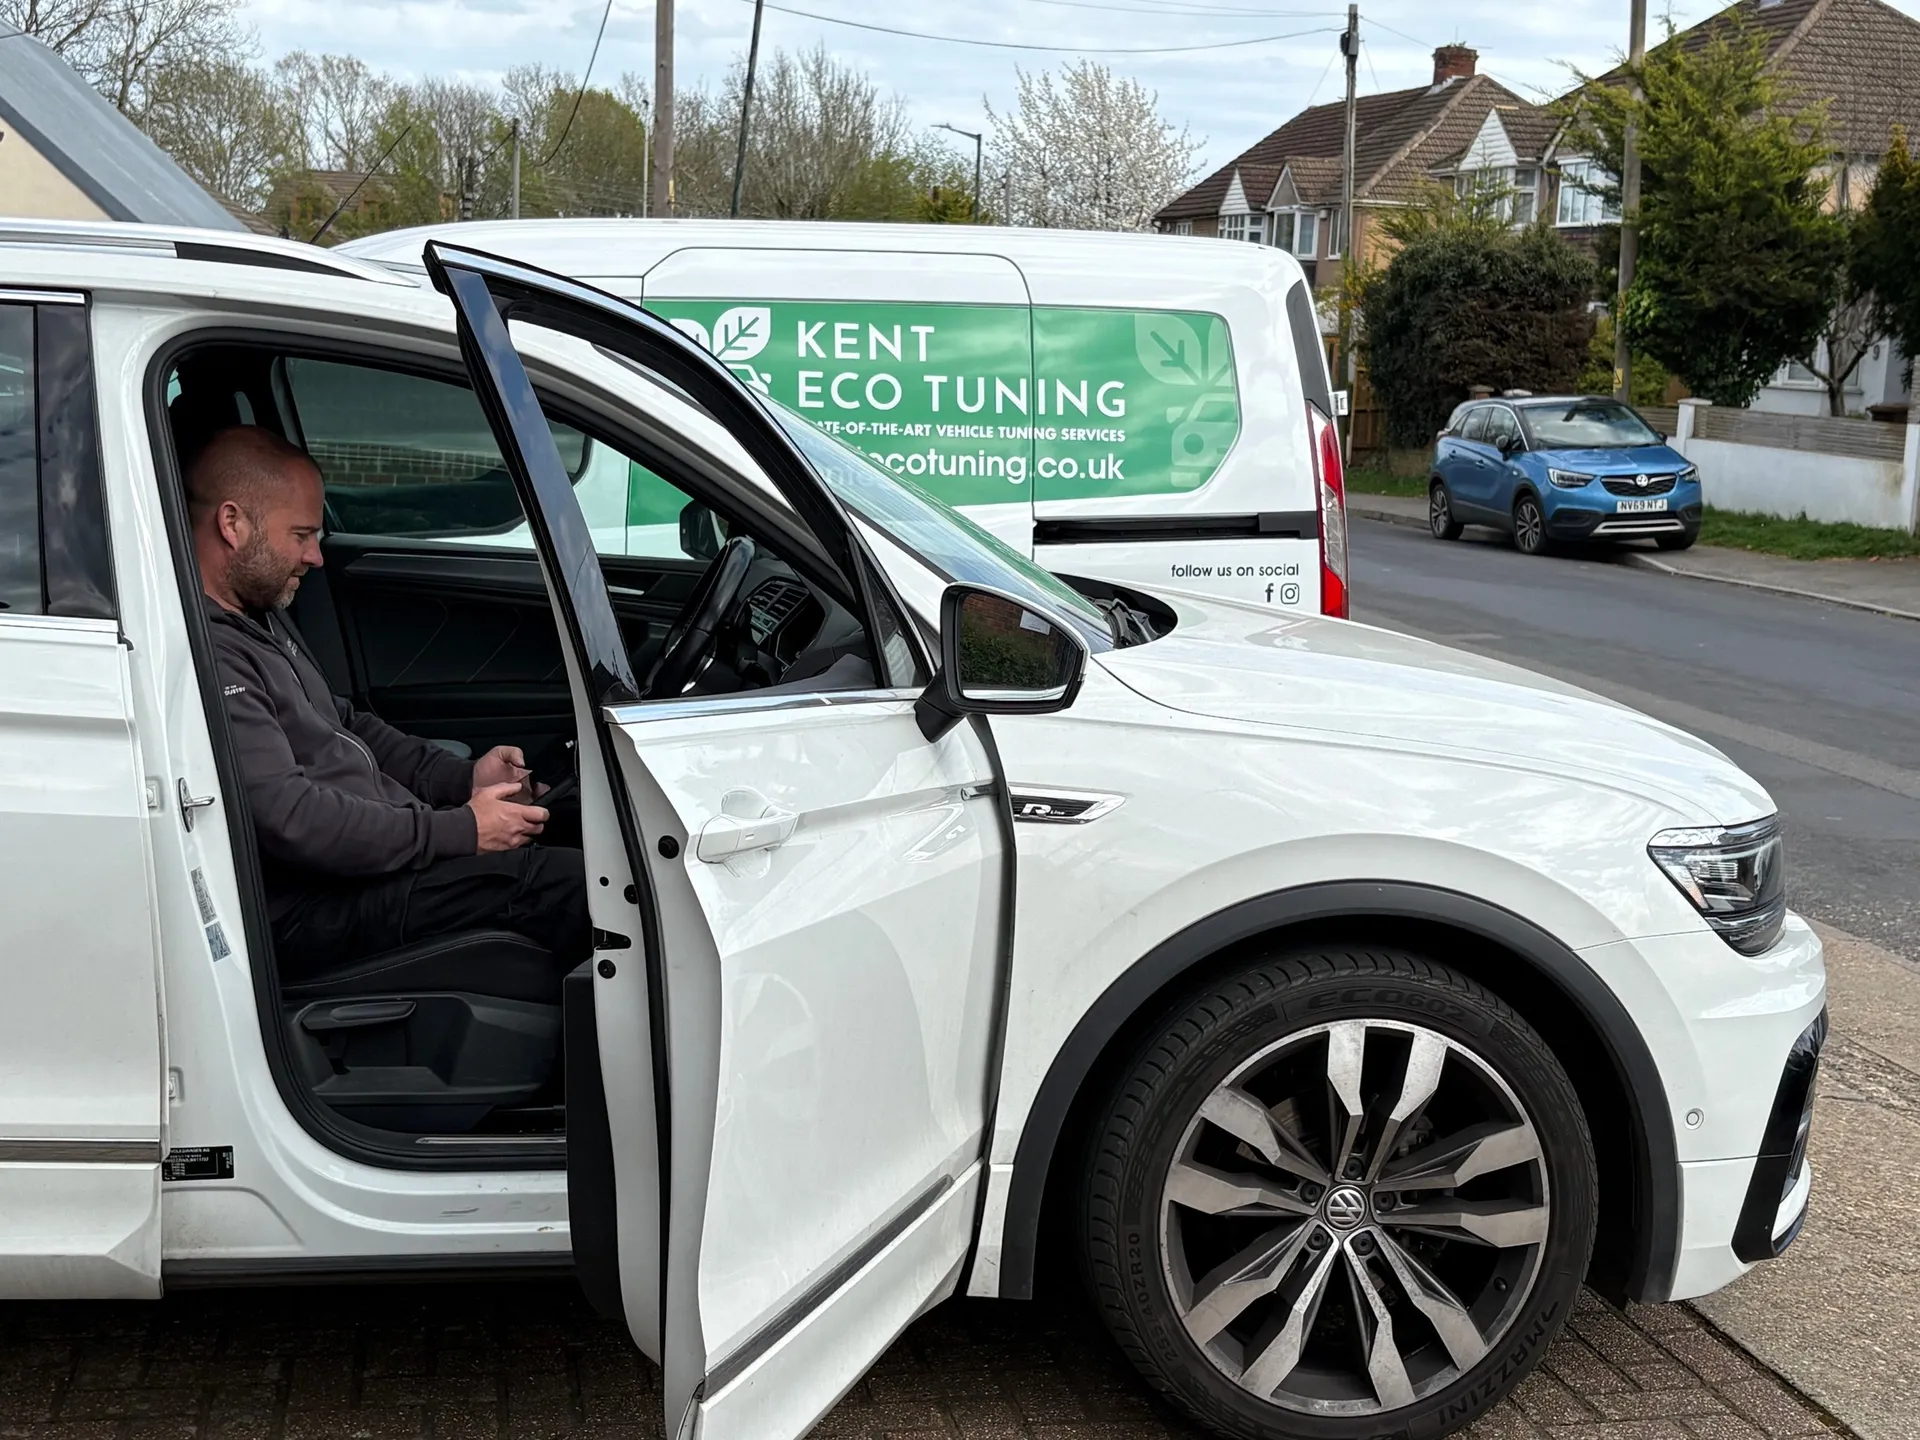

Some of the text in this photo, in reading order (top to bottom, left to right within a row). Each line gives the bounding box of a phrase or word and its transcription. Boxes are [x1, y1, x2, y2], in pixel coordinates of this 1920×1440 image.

[797, 320, 935, 362] KENT
[798, 370, 1126, 417] ECO TUNING
[936, 424, 994, 438] VEHICLE
[998, 426, 1057, 440] TUNING
[1061, 428, 1126, 442] SERVICES
[1620, 500, 1646, 511] NV69
[1171, 563, 1299, 577] follow us on social
[1022, 803, 1051, 817] R
[1437, 1319, 1546, 1426] MAZZINI
